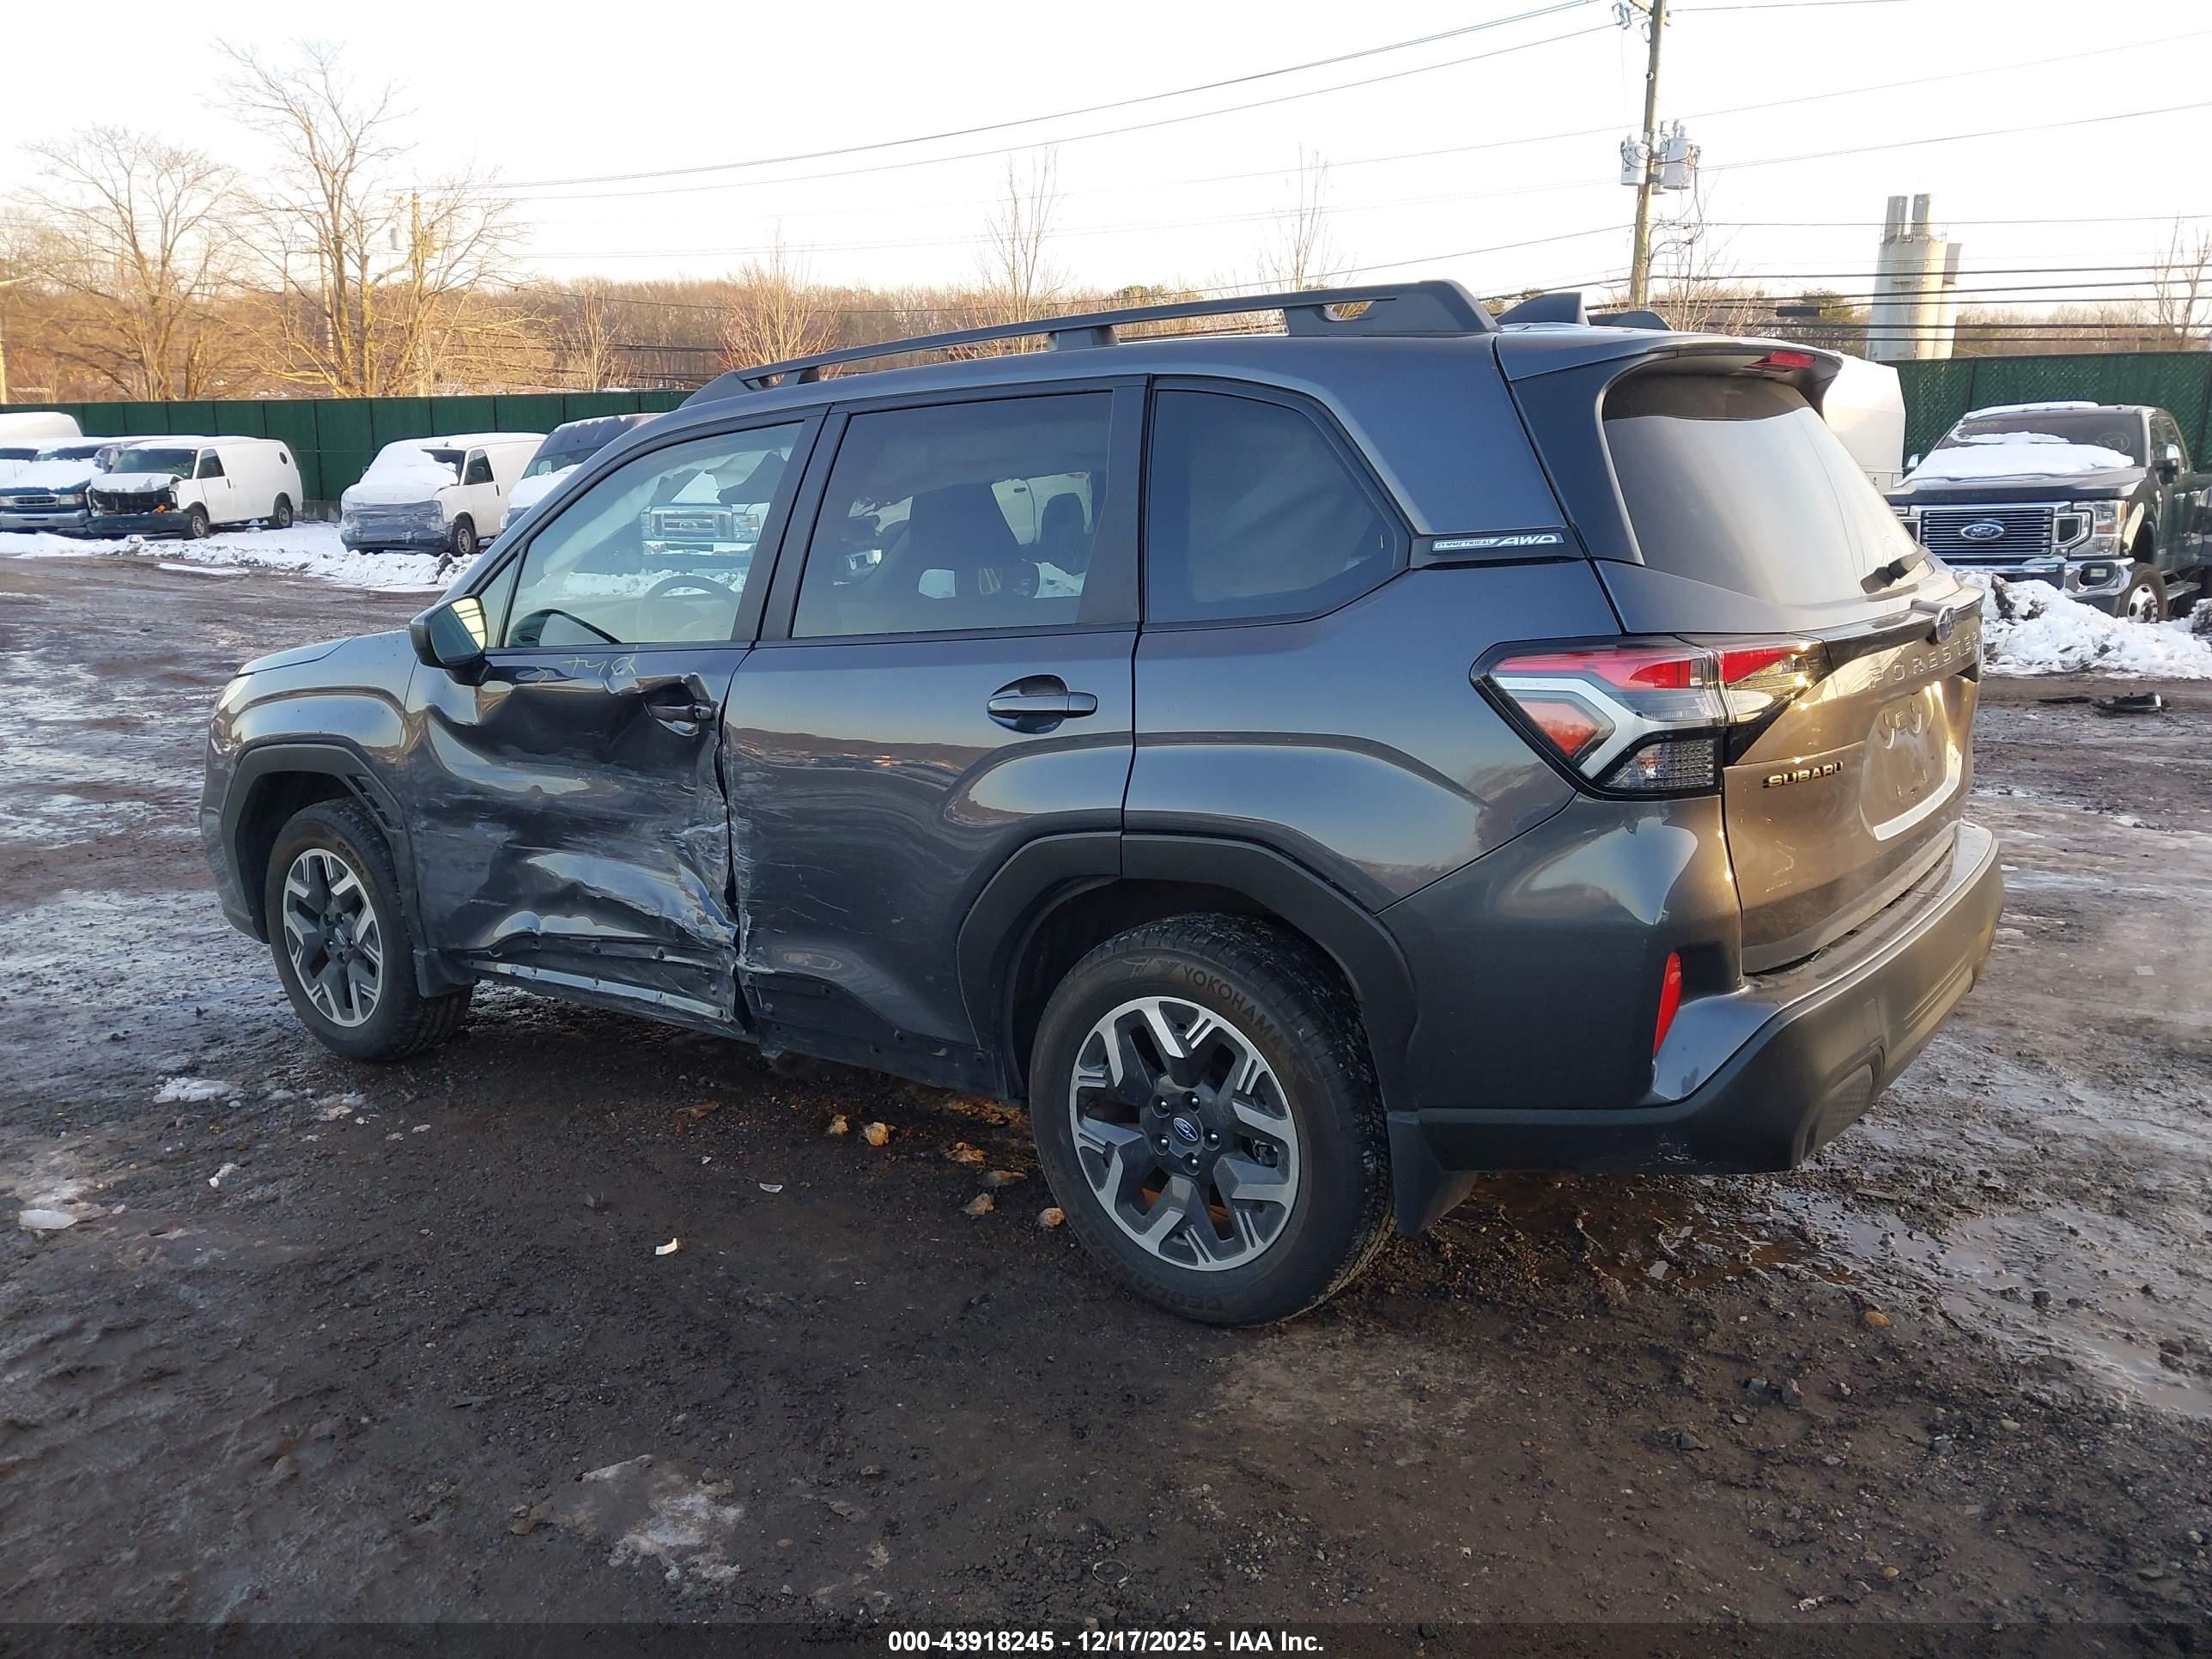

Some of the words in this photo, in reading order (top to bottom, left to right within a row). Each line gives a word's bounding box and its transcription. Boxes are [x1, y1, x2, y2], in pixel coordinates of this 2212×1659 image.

[1437, 539, 1493, 548] SYMMETRICAL
[1498, 534, 1559, 545] AWD
[1868, 631, 1980, 689] FORESTER
[1762, 761, 1844, 788] SUBARU
[1183, 964, 1284, 1049] YOKOHAMA
